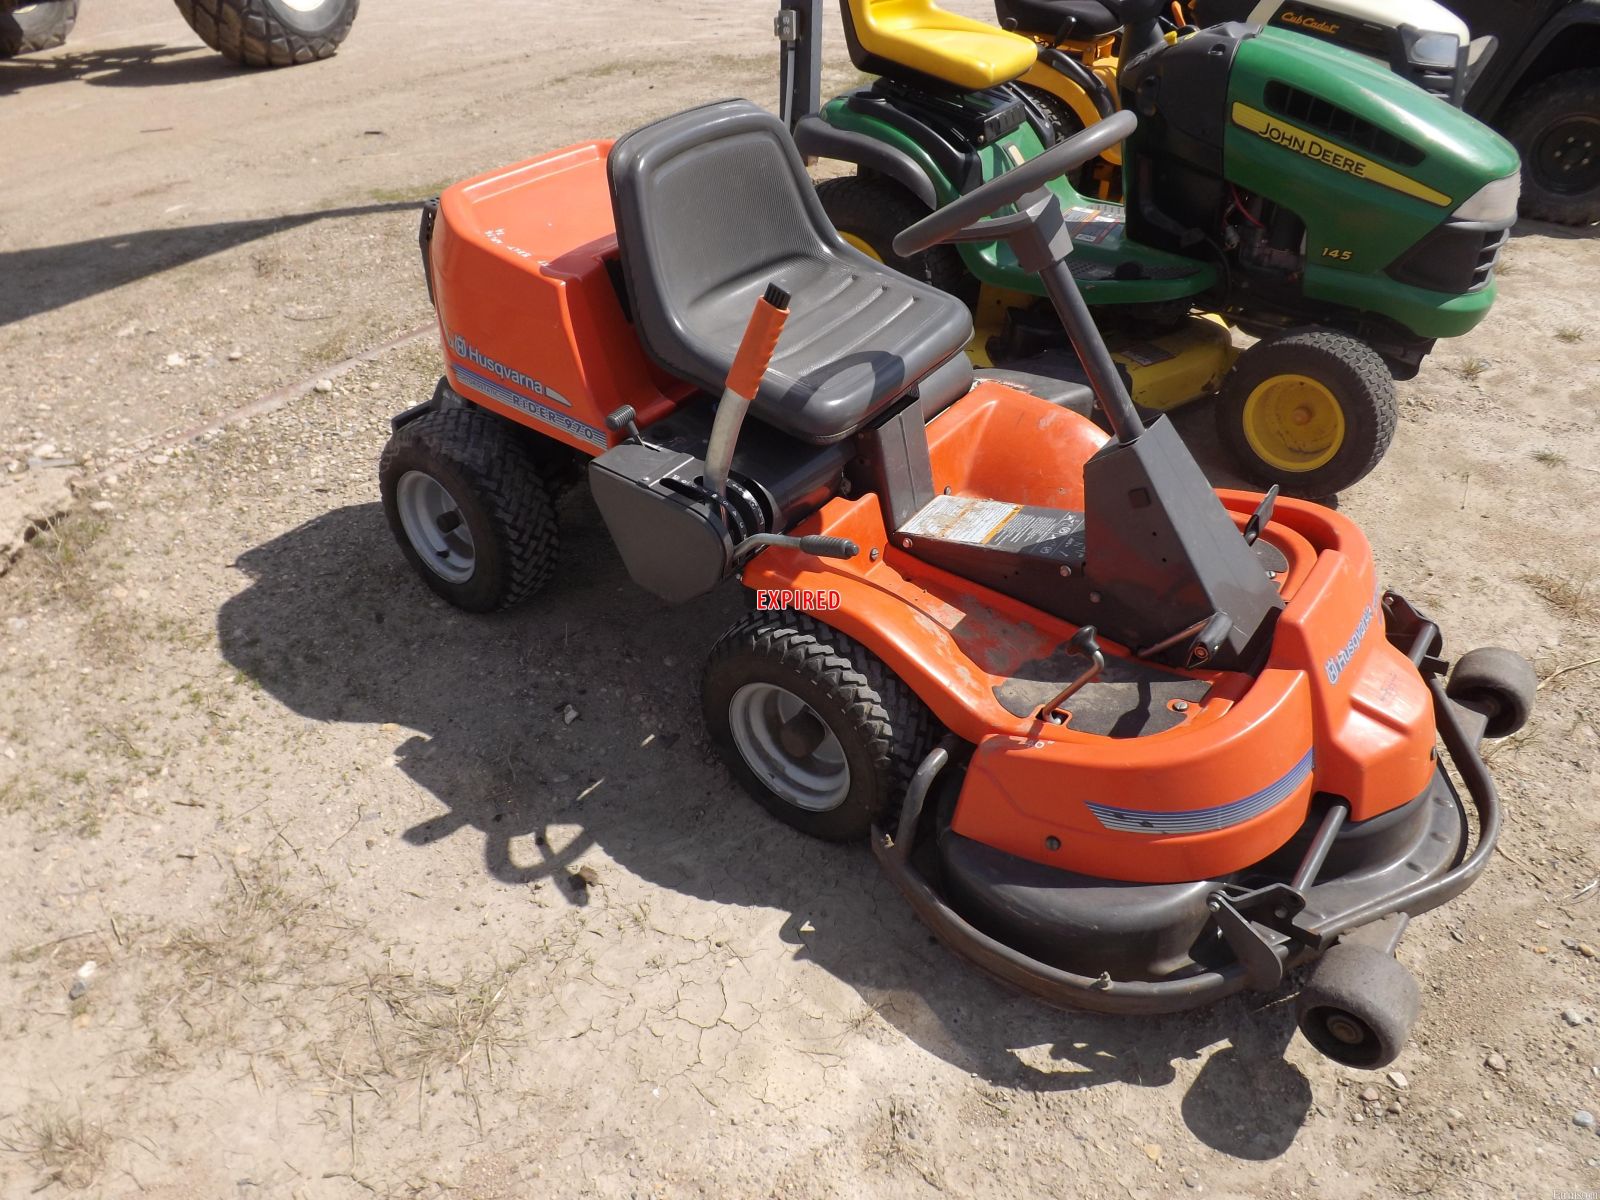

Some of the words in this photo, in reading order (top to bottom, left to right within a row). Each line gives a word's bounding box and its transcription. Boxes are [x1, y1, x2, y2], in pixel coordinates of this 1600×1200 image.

[1280, 11, 1303, 26] Cub
[1302, 16, 1340, 34] Cadet
[1258, 121, 1306, 153] JOHN
[1308, 140, 1367, 177] DEERE
[1321, 246, 1353, 261] 145
[468, 346, 545, 395] Husqvarna
[512, 394, 558, 423] RIDER
[564, 419, 594, 440] 970
